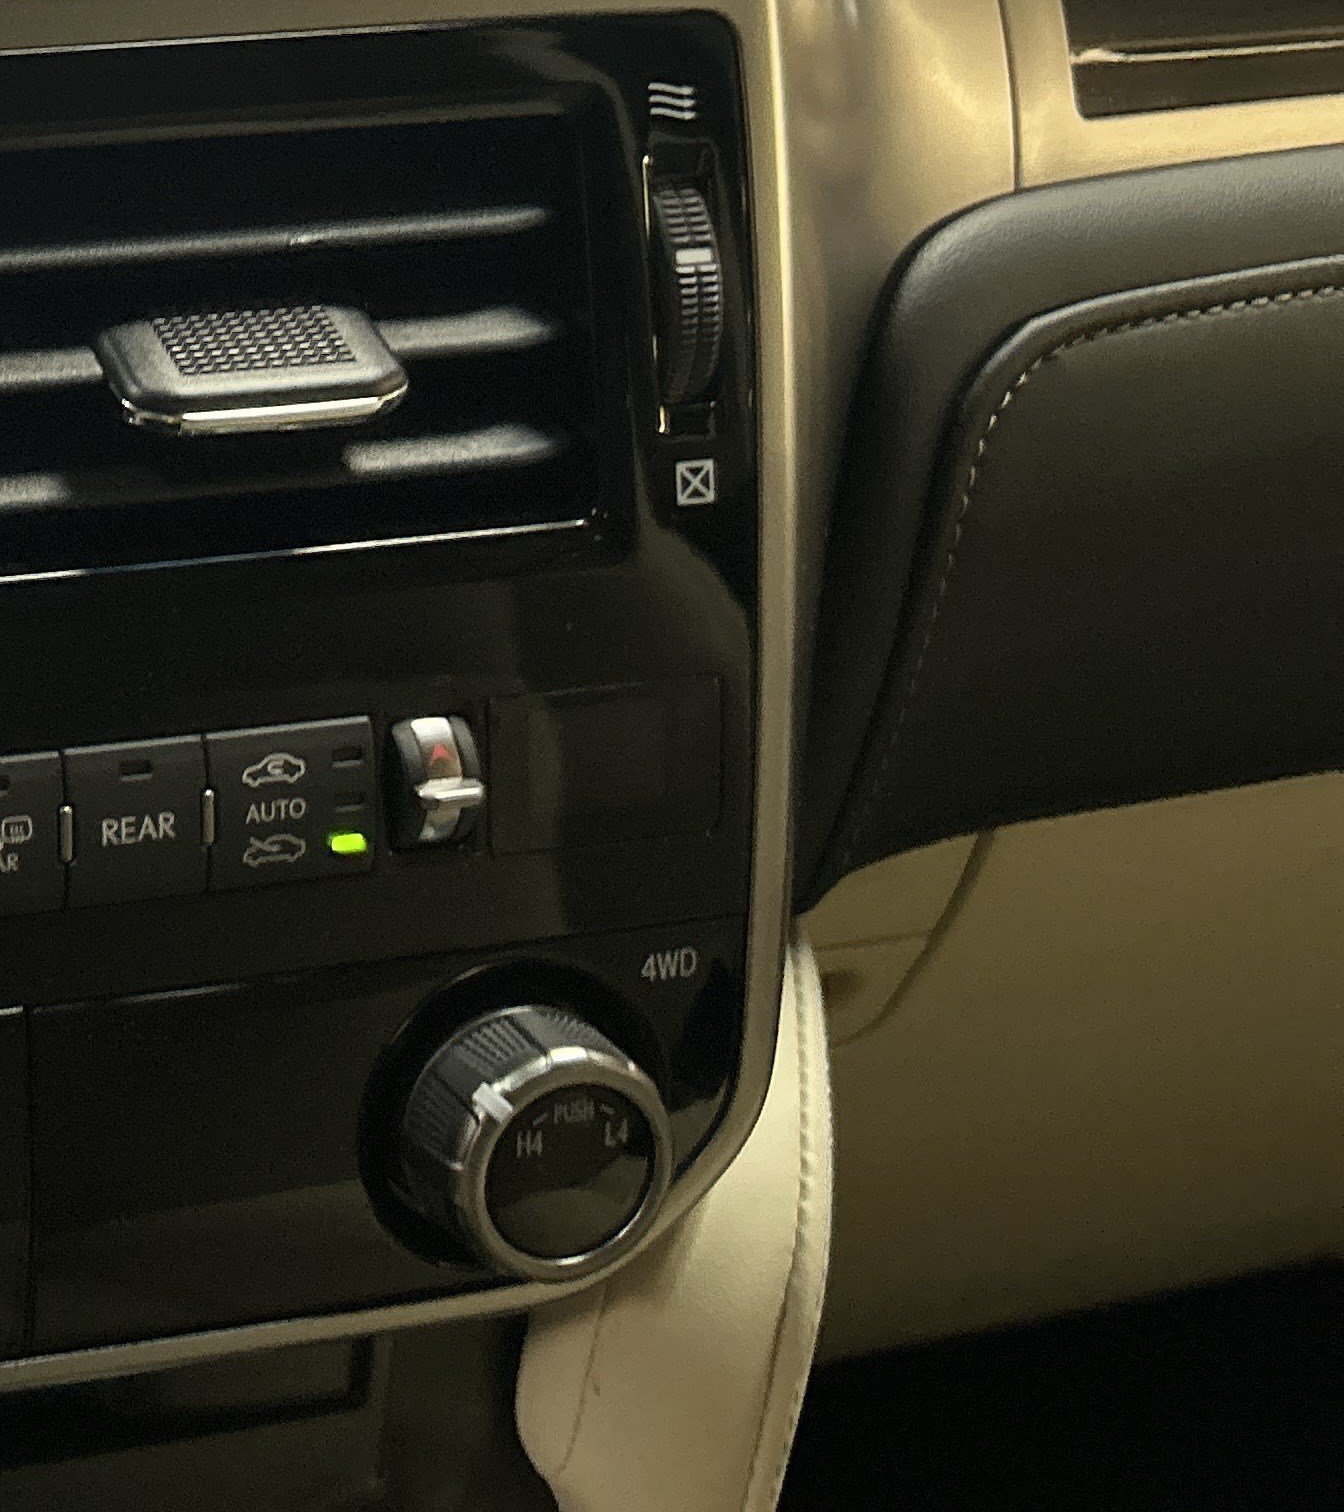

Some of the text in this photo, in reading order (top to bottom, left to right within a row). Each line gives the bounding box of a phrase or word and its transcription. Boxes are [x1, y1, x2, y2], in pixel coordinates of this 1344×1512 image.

[245, 798, 307, 824] AUTO
[100, 809, 176, 845] REAR
[640, 946, 698, 982] 4WD
[515, 1129, 544, 1158] H4
[603, 1118, 630, 1148] L4
